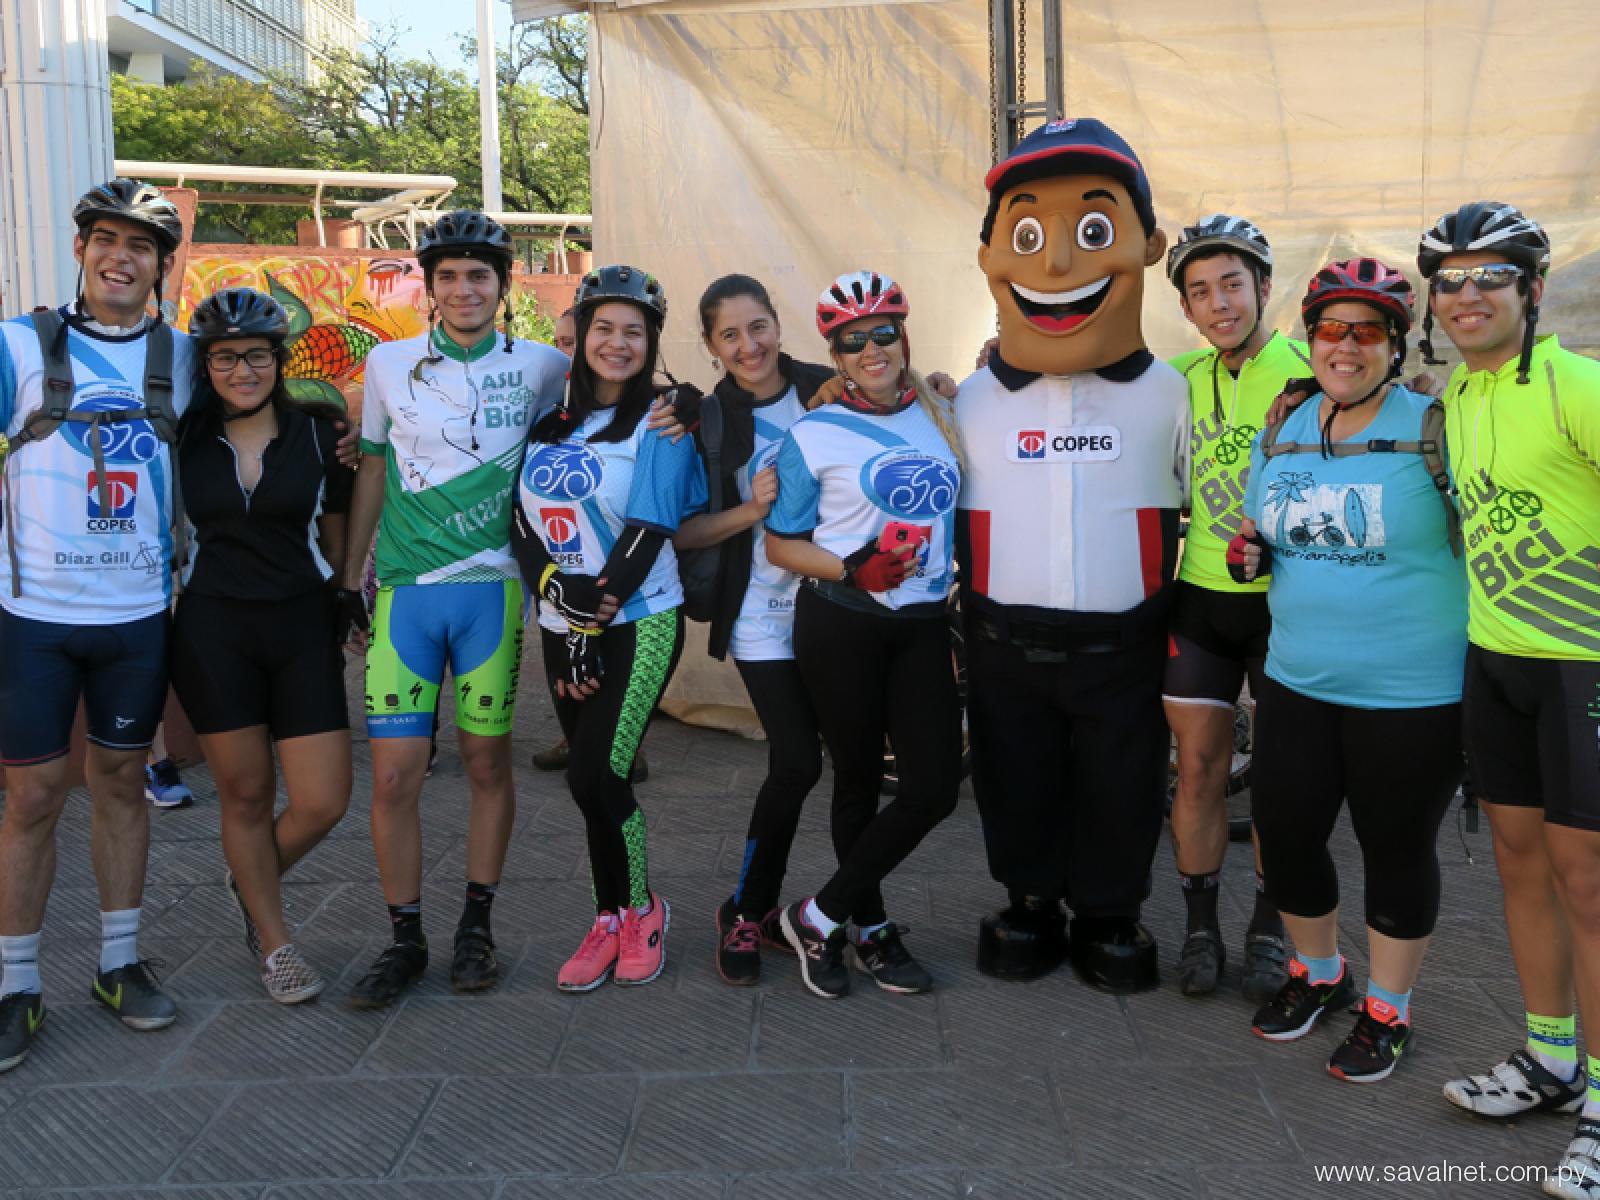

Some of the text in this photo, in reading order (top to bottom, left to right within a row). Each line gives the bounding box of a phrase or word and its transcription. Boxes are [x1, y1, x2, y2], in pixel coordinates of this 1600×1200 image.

[482, 370, 522, 390] ASU
[484, 405, 528, 428] Bici
[1191, 411, 1224, 455] SU
[1052, 435, 1113, 452] COPEG
[87, 519, 137, 531] COPEG
[100, 551, 130, 565] Gill
[1470, 519, 1566, 599] Bici
